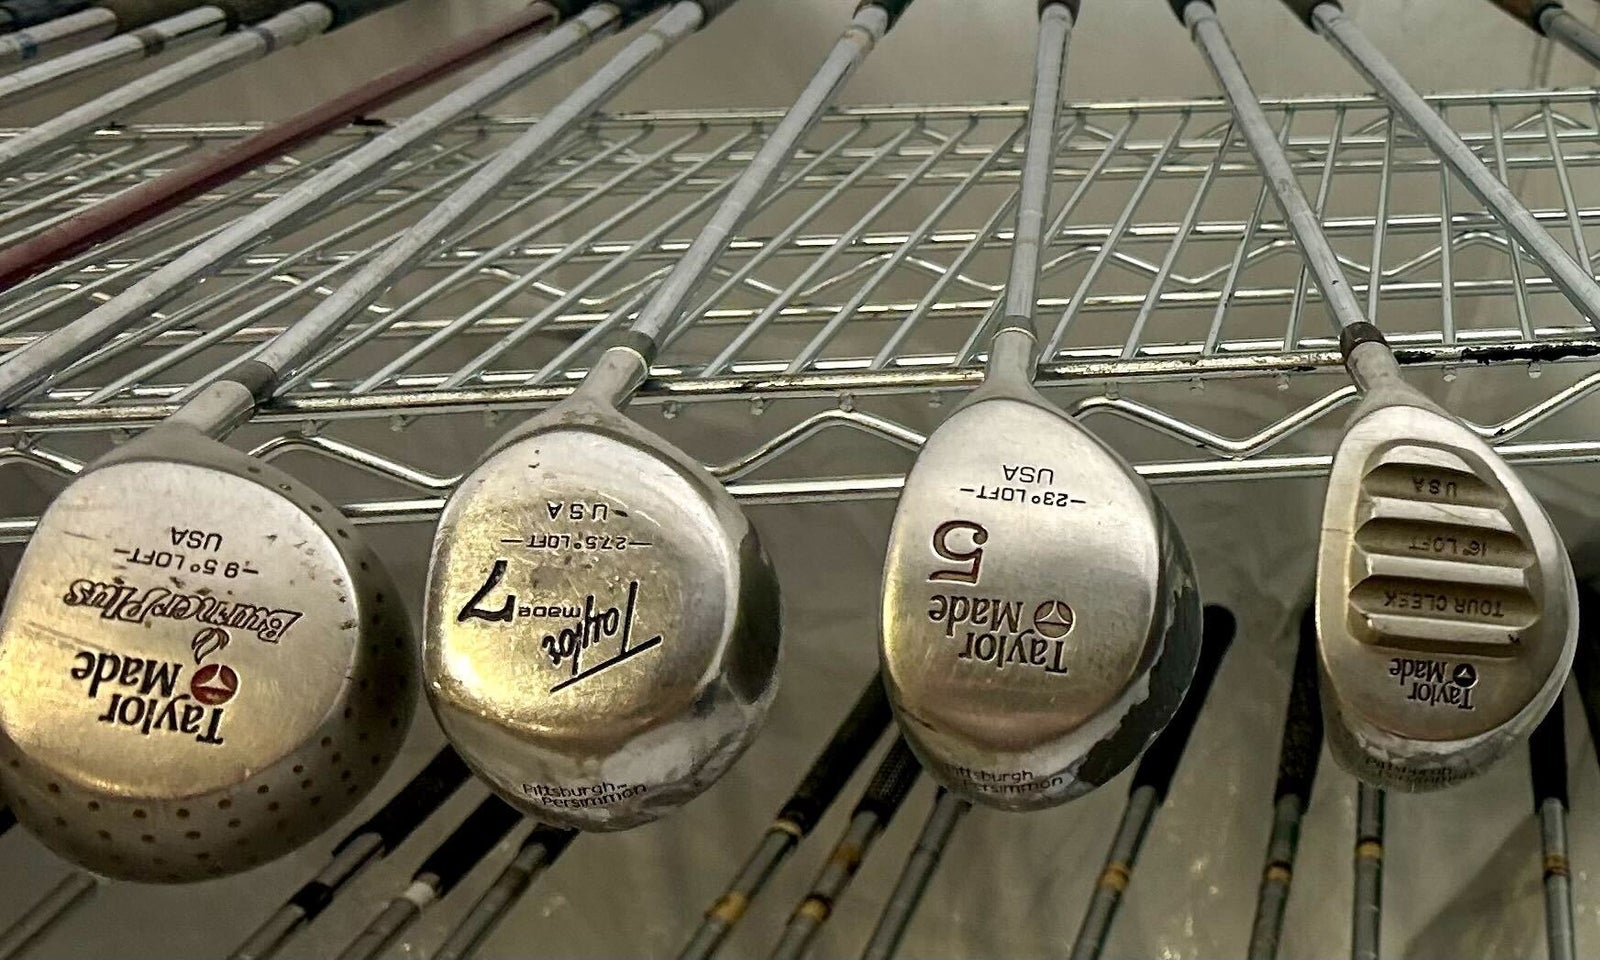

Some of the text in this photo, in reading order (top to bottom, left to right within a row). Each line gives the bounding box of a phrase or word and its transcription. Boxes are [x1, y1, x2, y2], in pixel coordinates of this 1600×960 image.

[1002, 464, 1054, 486] USA
[1412, 477, 1458, 499] USA
[546, 500, 609, 521] USA
[170, 526, 223, 553] USA
[926, 520, 989, 586] 5
[1408, 537, 1458, 556] LOFT
[457, 559, 516, 623] 7
[1383, 591, 1505, 618] TOUR CLEEK
[61, 578, 303, 645] Burner Plus
[517, 603, 582, 620] made
[927, 593, 1024, 638] Made
[542, 581, 662, 694] Taylor
[958, 628, 1068, 675] Taylor
[70, 651, 183, 700] Made
[1388, 657, 1448, 688] Made
[1408, 681, 1475, 711] Taylor
[98, 694, 224, 746] Taylor
[541, 783, 648, 808] Persimmon
